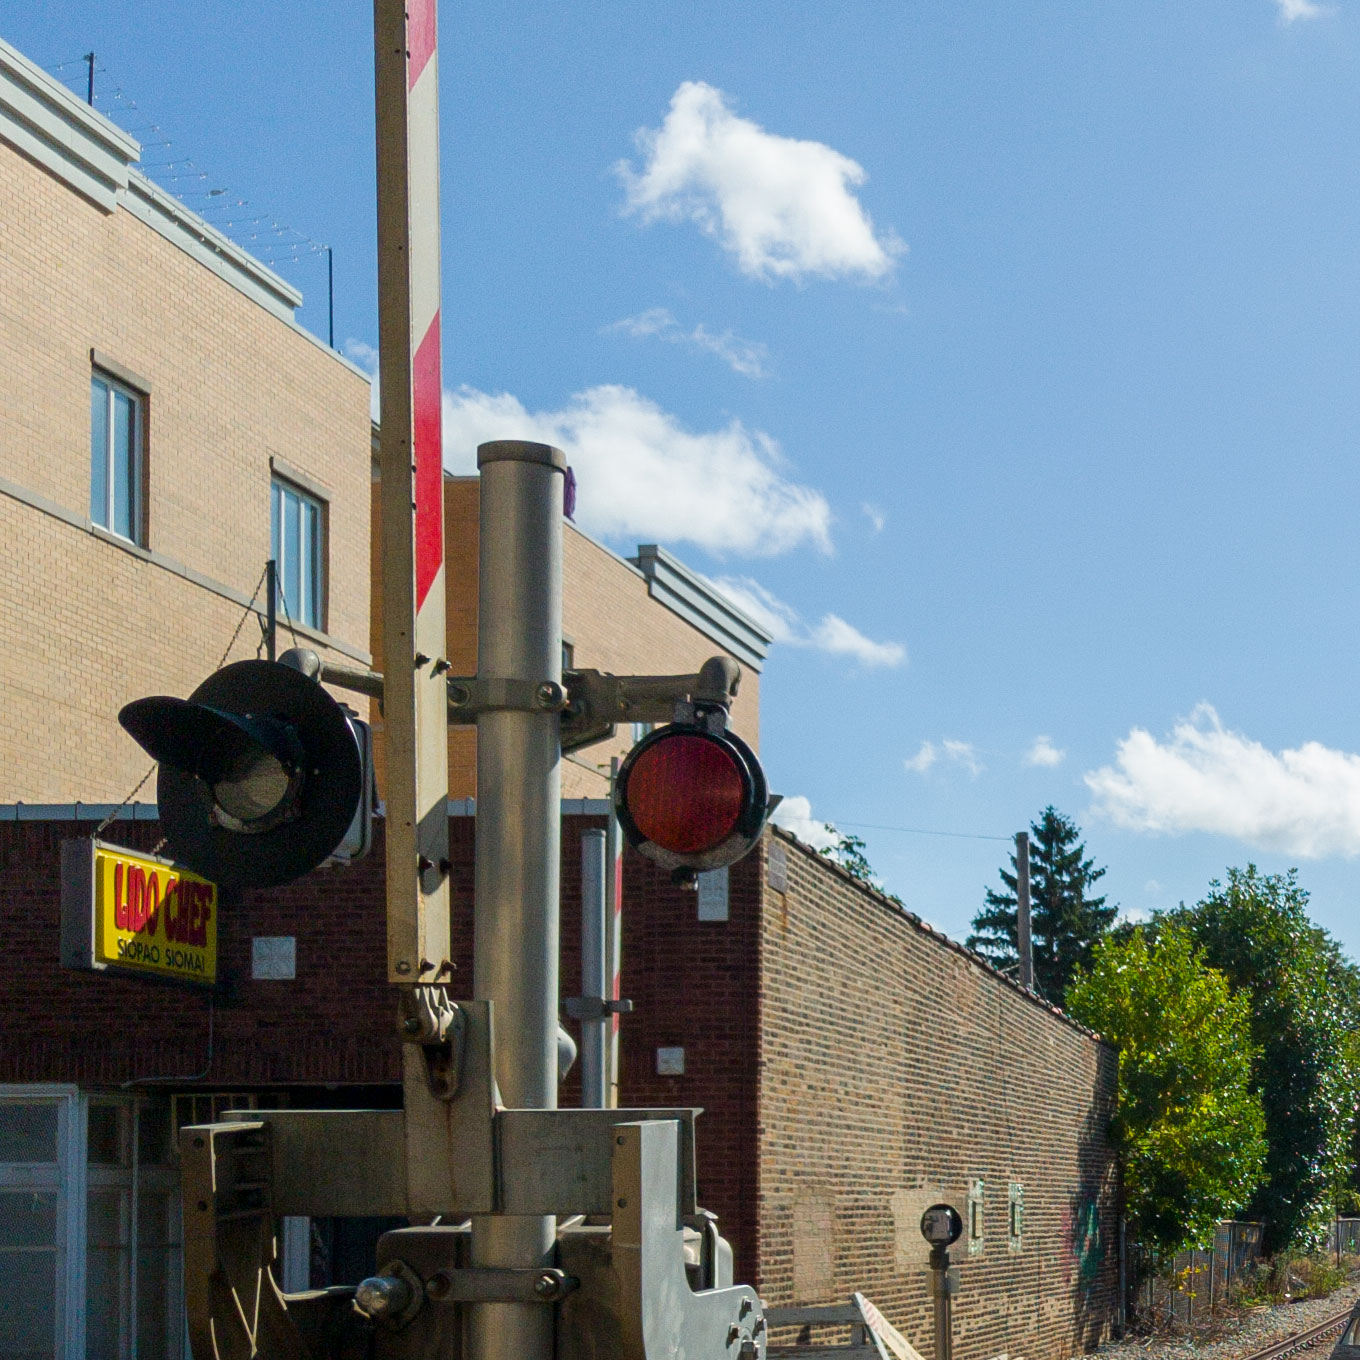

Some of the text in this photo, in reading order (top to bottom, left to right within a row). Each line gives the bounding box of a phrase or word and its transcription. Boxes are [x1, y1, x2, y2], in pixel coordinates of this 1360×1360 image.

[115, 863, 213, 948] LIDO CHEF
[117, 938, 205, 971] SIOPAO SIOMAI
